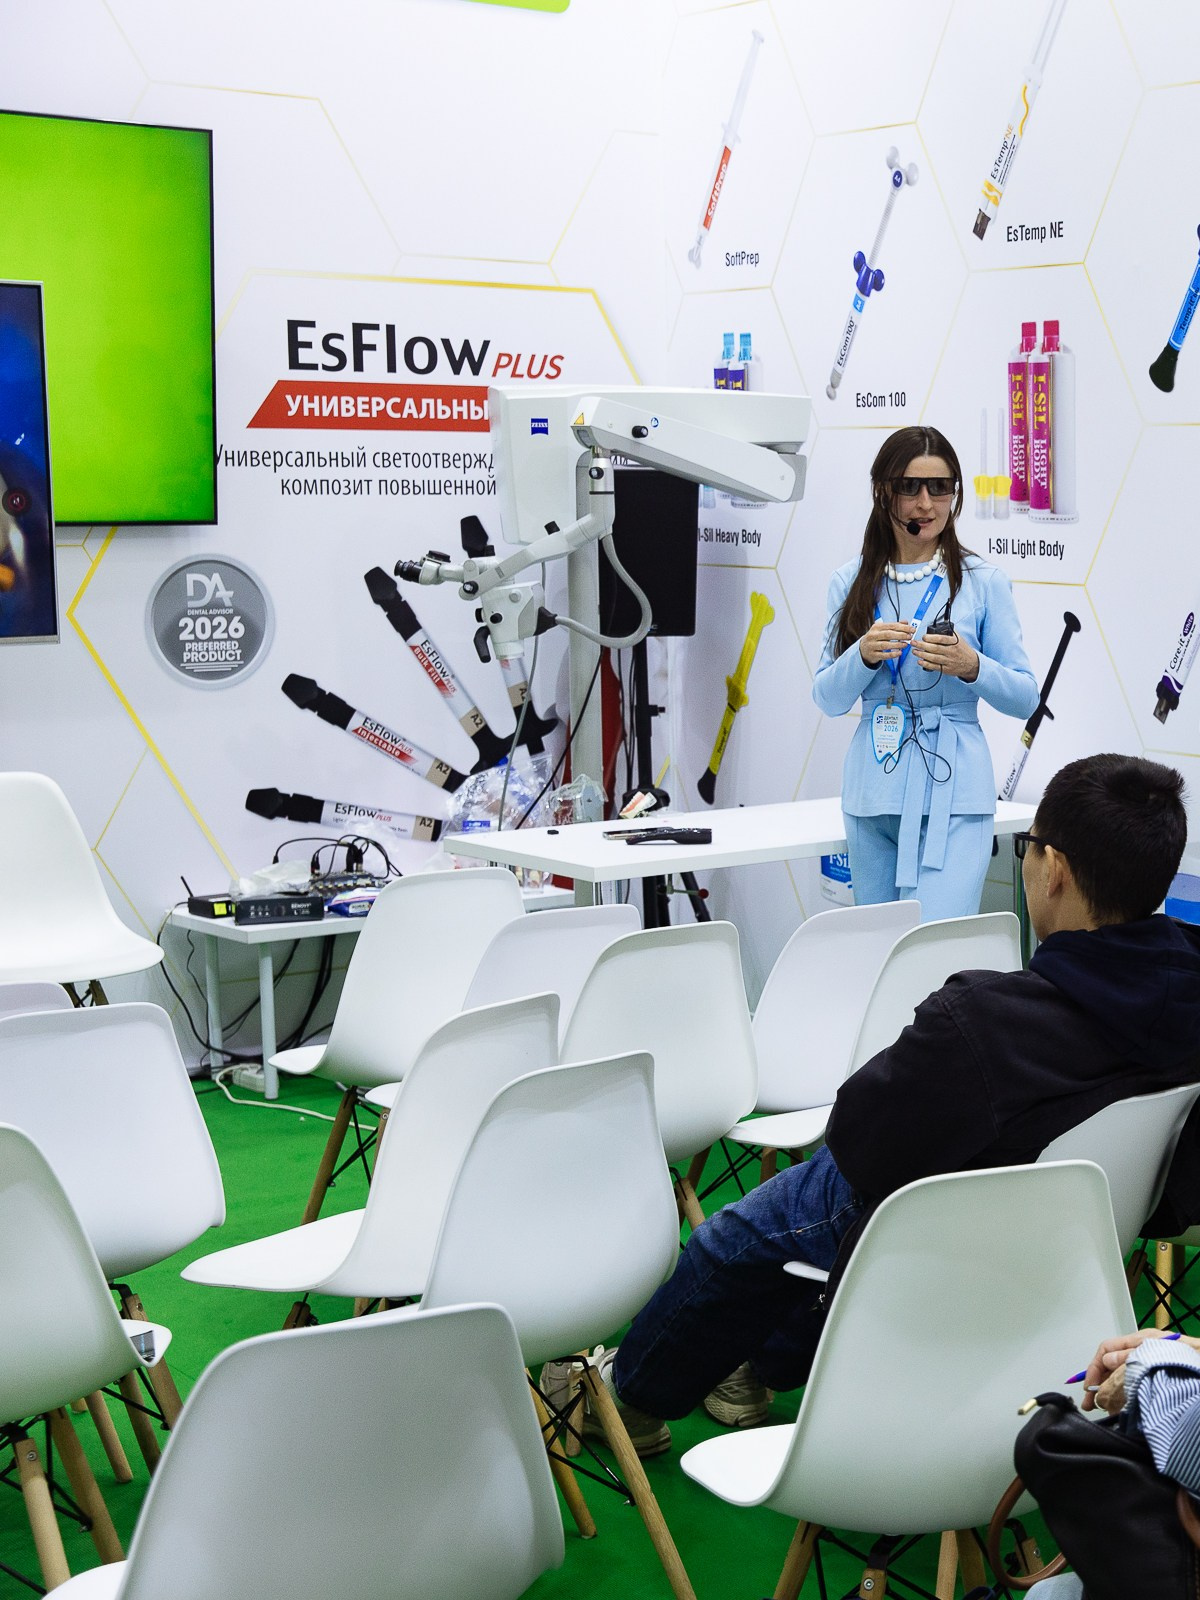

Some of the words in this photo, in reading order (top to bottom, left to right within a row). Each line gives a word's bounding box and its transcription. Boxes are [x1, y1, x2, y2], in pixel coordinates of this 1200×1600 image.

[1007, 224, 1046, 243] EsTemp
[1050, 221, 1064, 239] NE
[725, 251, 760, 267] SoftPrep
[287, 319, 491, 377] EsFlow
[491, 353, 564, 380] PLUS
[856, 393, 885, 408] EsCom
[888, 391, 906, 407] 100
[1034, 439, 1042, 484] BODY
[281, 478, 372, 497] композит
[378, 477, 497, 497] повышенной
[715, 528, 739, 546] Heavy
[742, 529, 762, 547] Body
[989, 538, 1008, 556] I-Sil
[1011, 539, 1037, 560] Light
[1039, 541, 1065, 561] Body
[187, 608, 209, 616] DENTAL
[178, 616, 245, 640] 2026
[185, 641, 239, 652] PREFERRED
[183, 650, 241, 663] PRODUCT
[413, 647, 428, 667] Bulk
[428, 668, 440, 683] Fill
[421, 640, 449, 678] EsFlow
[470, 713, 483, 728] A2
[362, 716, 401, 745] EsFlow
[357, 727, 400, 757] Injectable
[436, 762, 450, 775] A2
[334, 803, 377, 819] EsFlow
[419, 818, 433, 828] A2
